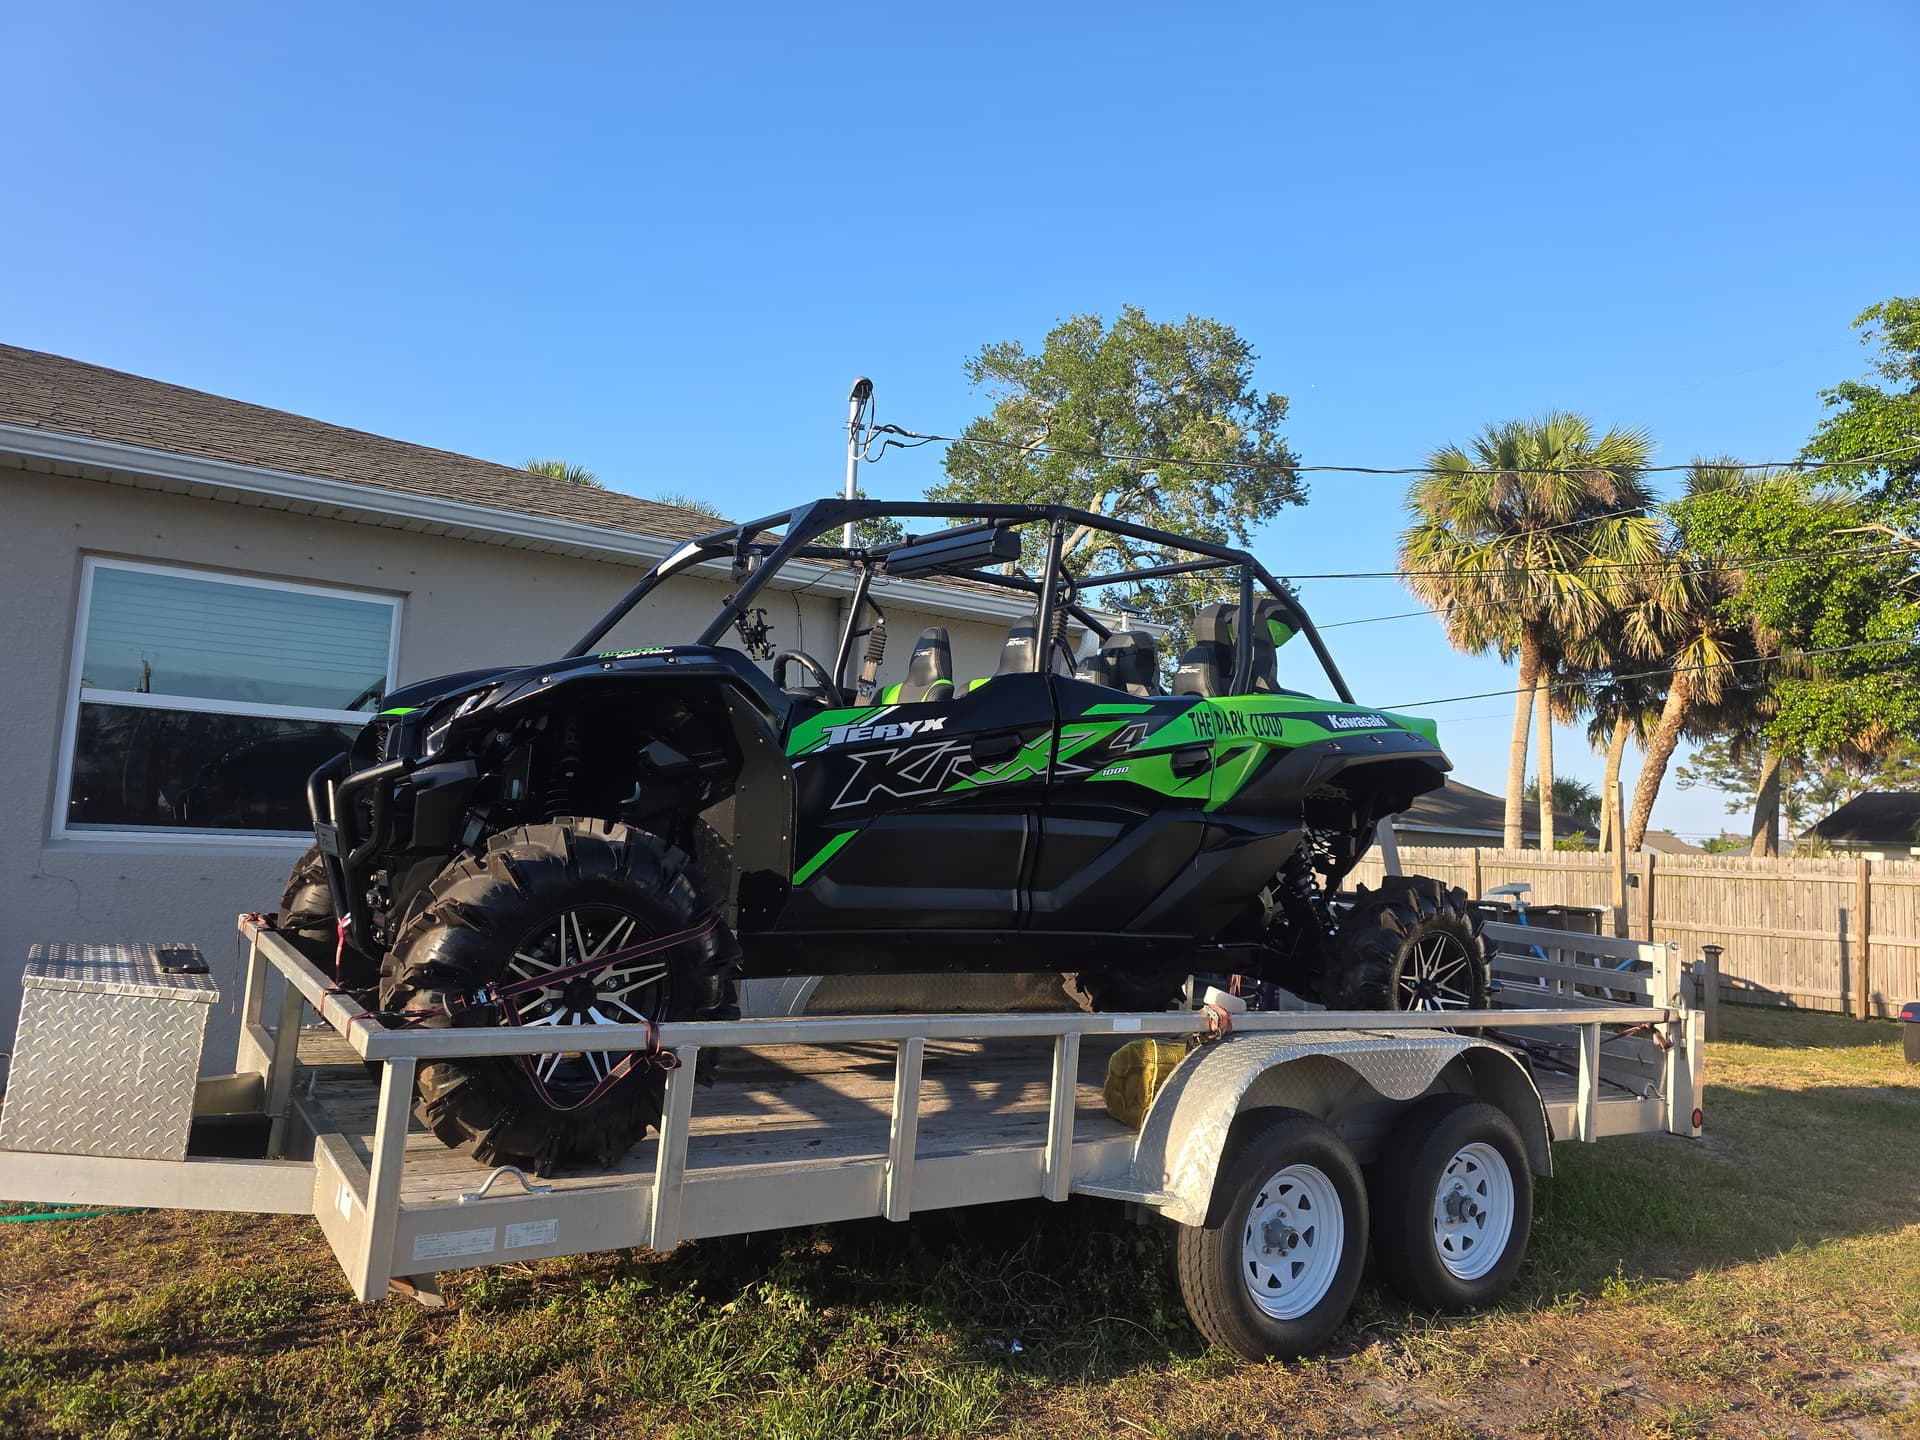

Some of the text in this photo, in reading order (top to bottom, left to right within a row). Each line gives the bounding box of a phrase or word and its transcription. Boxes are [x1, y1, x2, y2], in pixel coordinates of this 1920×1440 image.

[821, 716, 948, 745] TERYX
[1187, 710, 1284, 737] THE DARK CLOUD
[1327, 714, 1388, 729] Kawasaki
[1102, 766, 1130, 777] 1000
